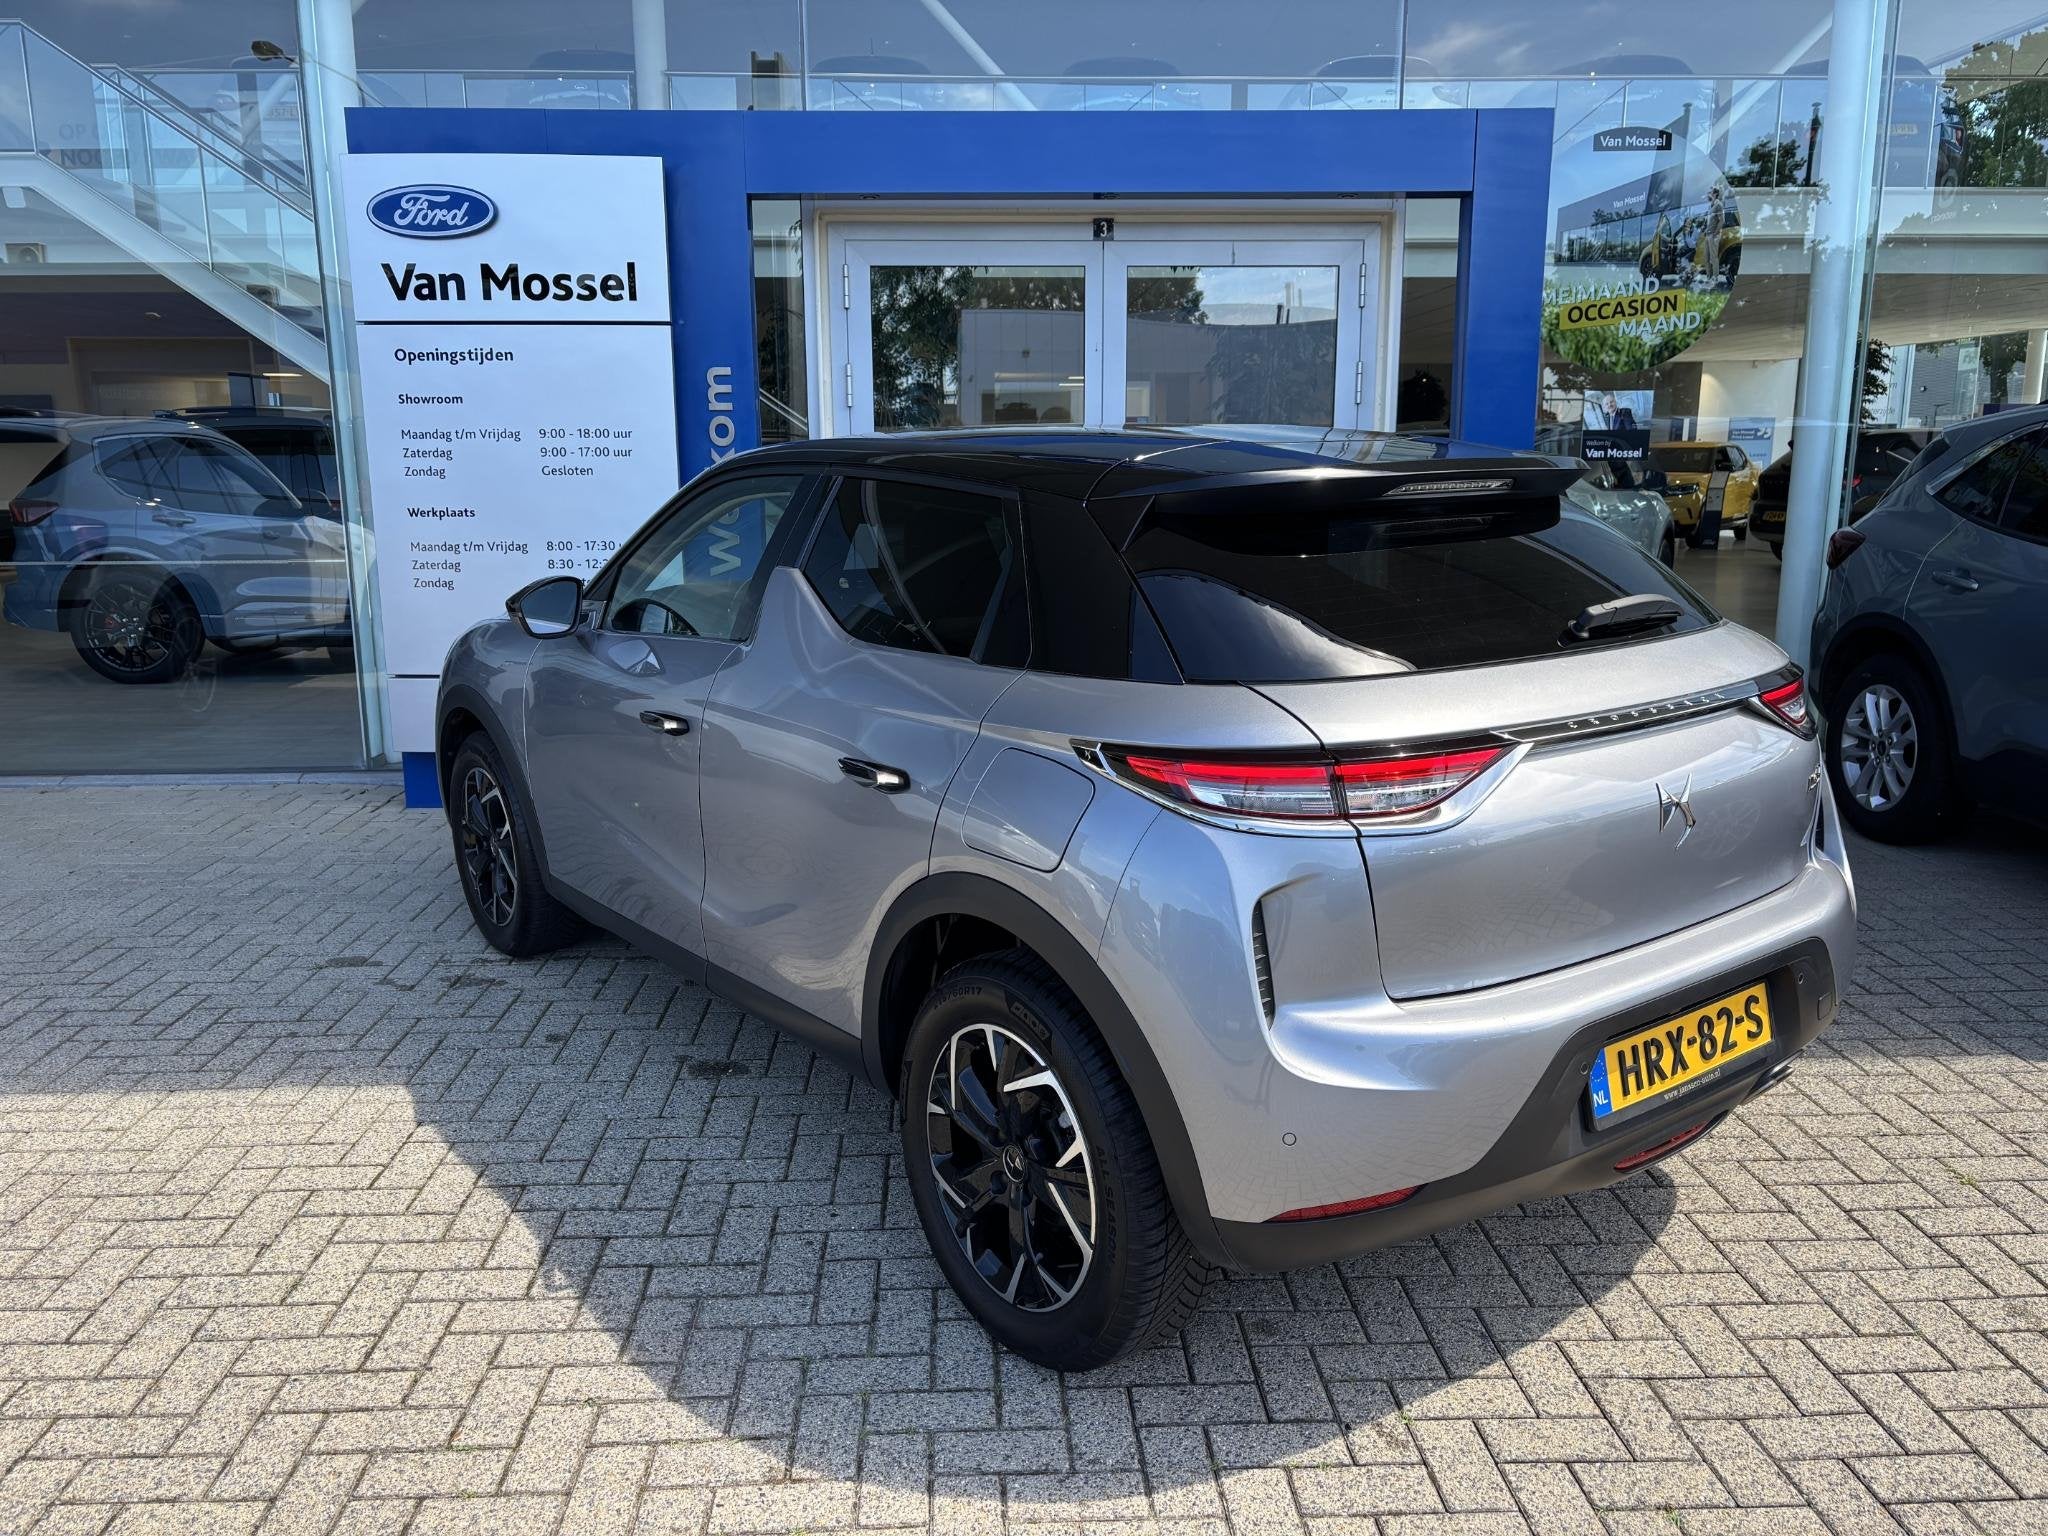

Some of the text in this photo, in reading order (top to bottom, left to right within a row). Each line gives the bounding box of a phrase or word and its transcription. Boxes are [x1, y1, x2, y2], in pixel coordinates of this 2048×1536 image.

[1601, 134, 1666, 147] Van Mossel
[393, 193, 469, 227] Ford
[1100, 221, 1108, 237] 3
[381, 262, 637, 301] Van Mossel
[1567, 294, 1678, 323] OCCASION
[1618, 312, 1701, 337] MAAND
[394, 348, 513, 365] Openingstijden
[399, 394, 463, 404] Showroom
[401, 428, 452, 442] Maandag
[455, 429, 476, 439] t/m
[479, 428, 521, 442] Vrijdag
[539, 429, 565, 438] 9:00
[577, 429, 609, 438] 18:00
[403, 448, 453, 461] Zaterdag
[541, 447, 566, 457] 9:00
[578, 447, 609, 457] 17:00
[1585, 448, 1642, 458] Van Mossel
[404, 465, 593, 479] Zondag Gesloten
[407, 507, 475, 520] Werkplaats
[411, 541, 460, 554] Maandag
[463, 541, 484, 552] t/m
[487, 541, 528, 554] Vrijdag
[547, 541, 572, 551] 8:00
[584, 541, 615, 550] 17:30
[412, 560, 461, 572] Zaterdag
[548, 559, 573, 569] 8:30
[414, 577, 455, 590] Zondag
[1617, 995, 1763, 1097] HRX-82-S
[1593, 1090, 1608, 1107] NL
